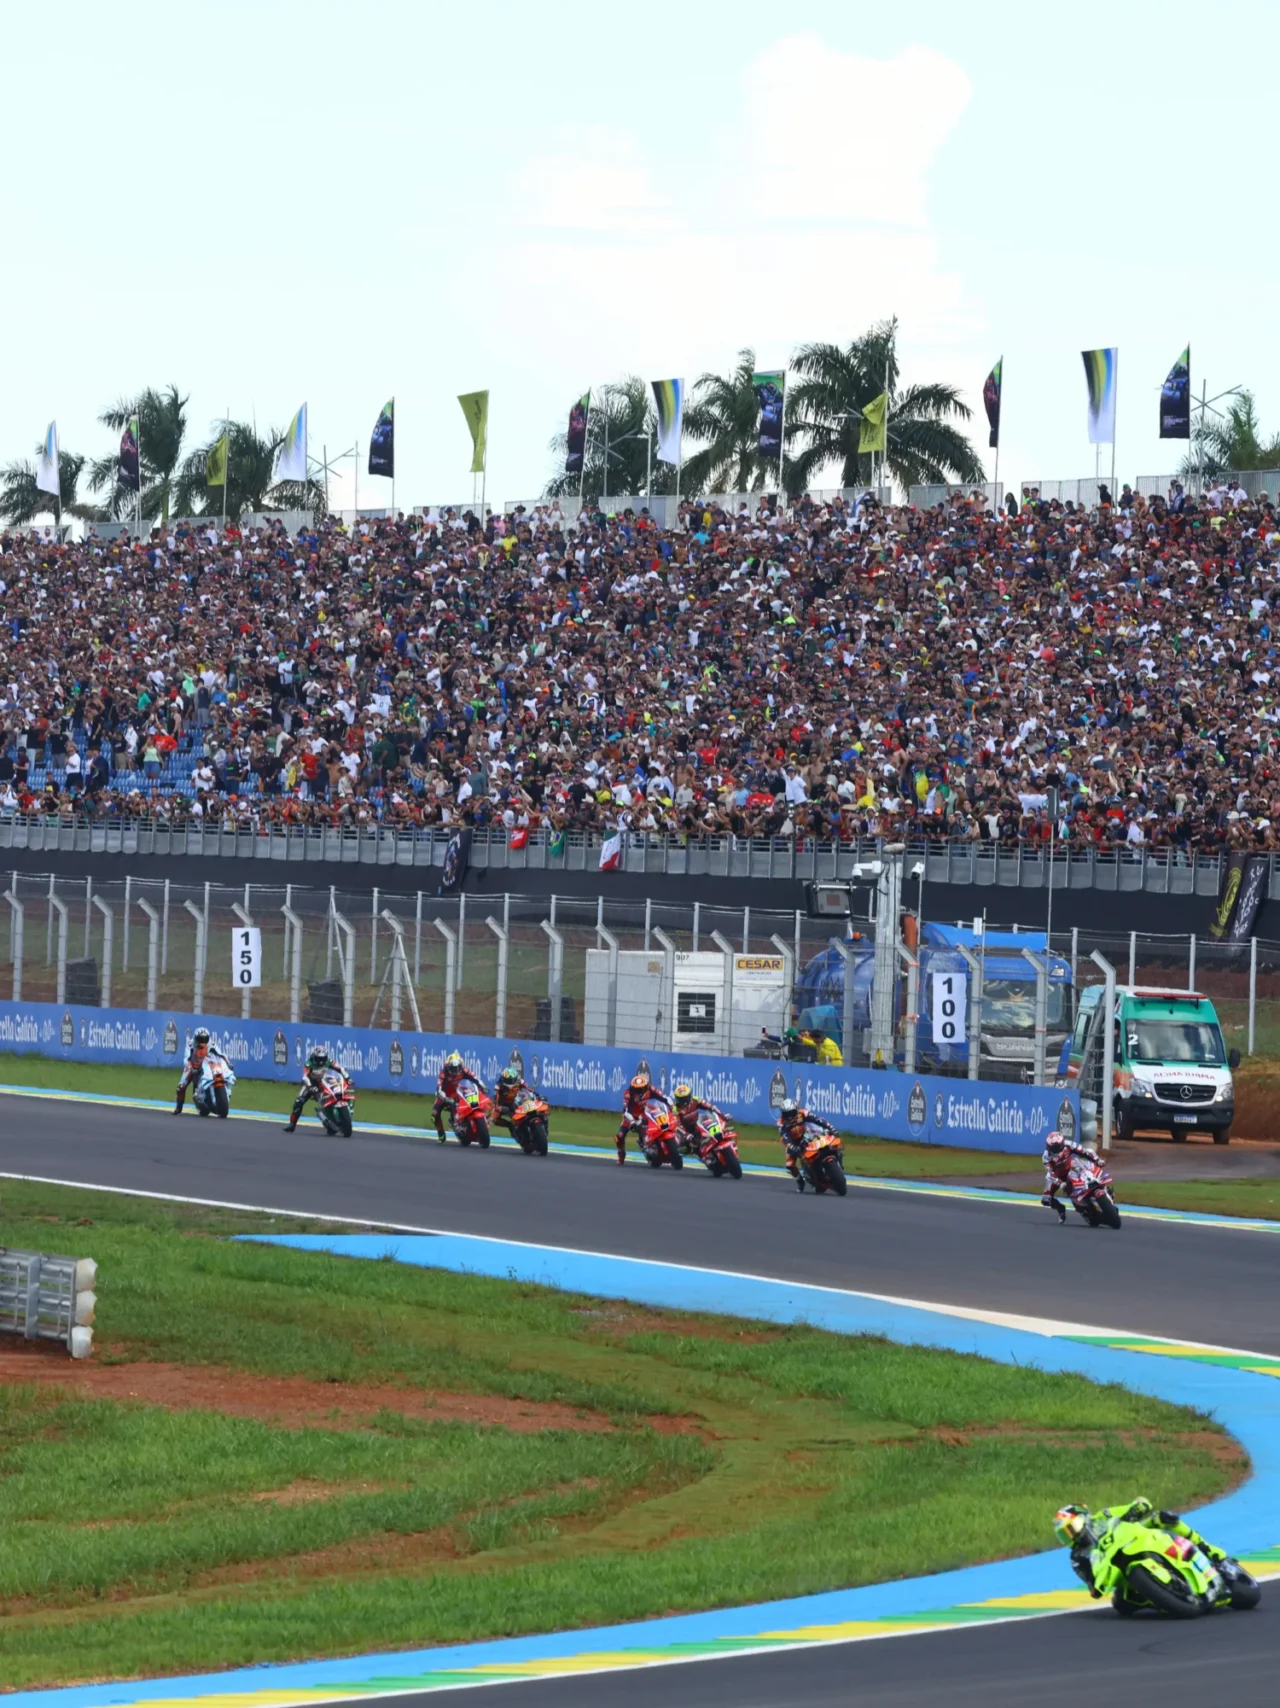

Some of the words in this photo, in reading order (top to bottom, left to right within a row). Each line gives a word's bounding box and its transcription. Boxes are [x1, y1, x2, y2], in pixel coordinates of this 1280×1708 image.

[240, 931, 252, 984] 150
[737, 959, 781, 970] CESAR
[942, 977, 956, 1039] 100
[15, 1013, 38, 1042] Galicia
[87, 1020, 114, 1048] Estrella
[115, 1020, 140, 1050] Galicia
[1128, 1034, 1139, 1046] 2
[542, 1057, 574, 1090] Estrella
[575, 1058, 606, 1092] Galicia
[705, 1069, 738, 1104] Galicia
[805, 1079, 841, 1114] Estrella
[842, 1082, 876, 1118] Galicia
[947, 1094, 986, 1130] Estrella
[988, 1097, 1023, 1135] Galicia
